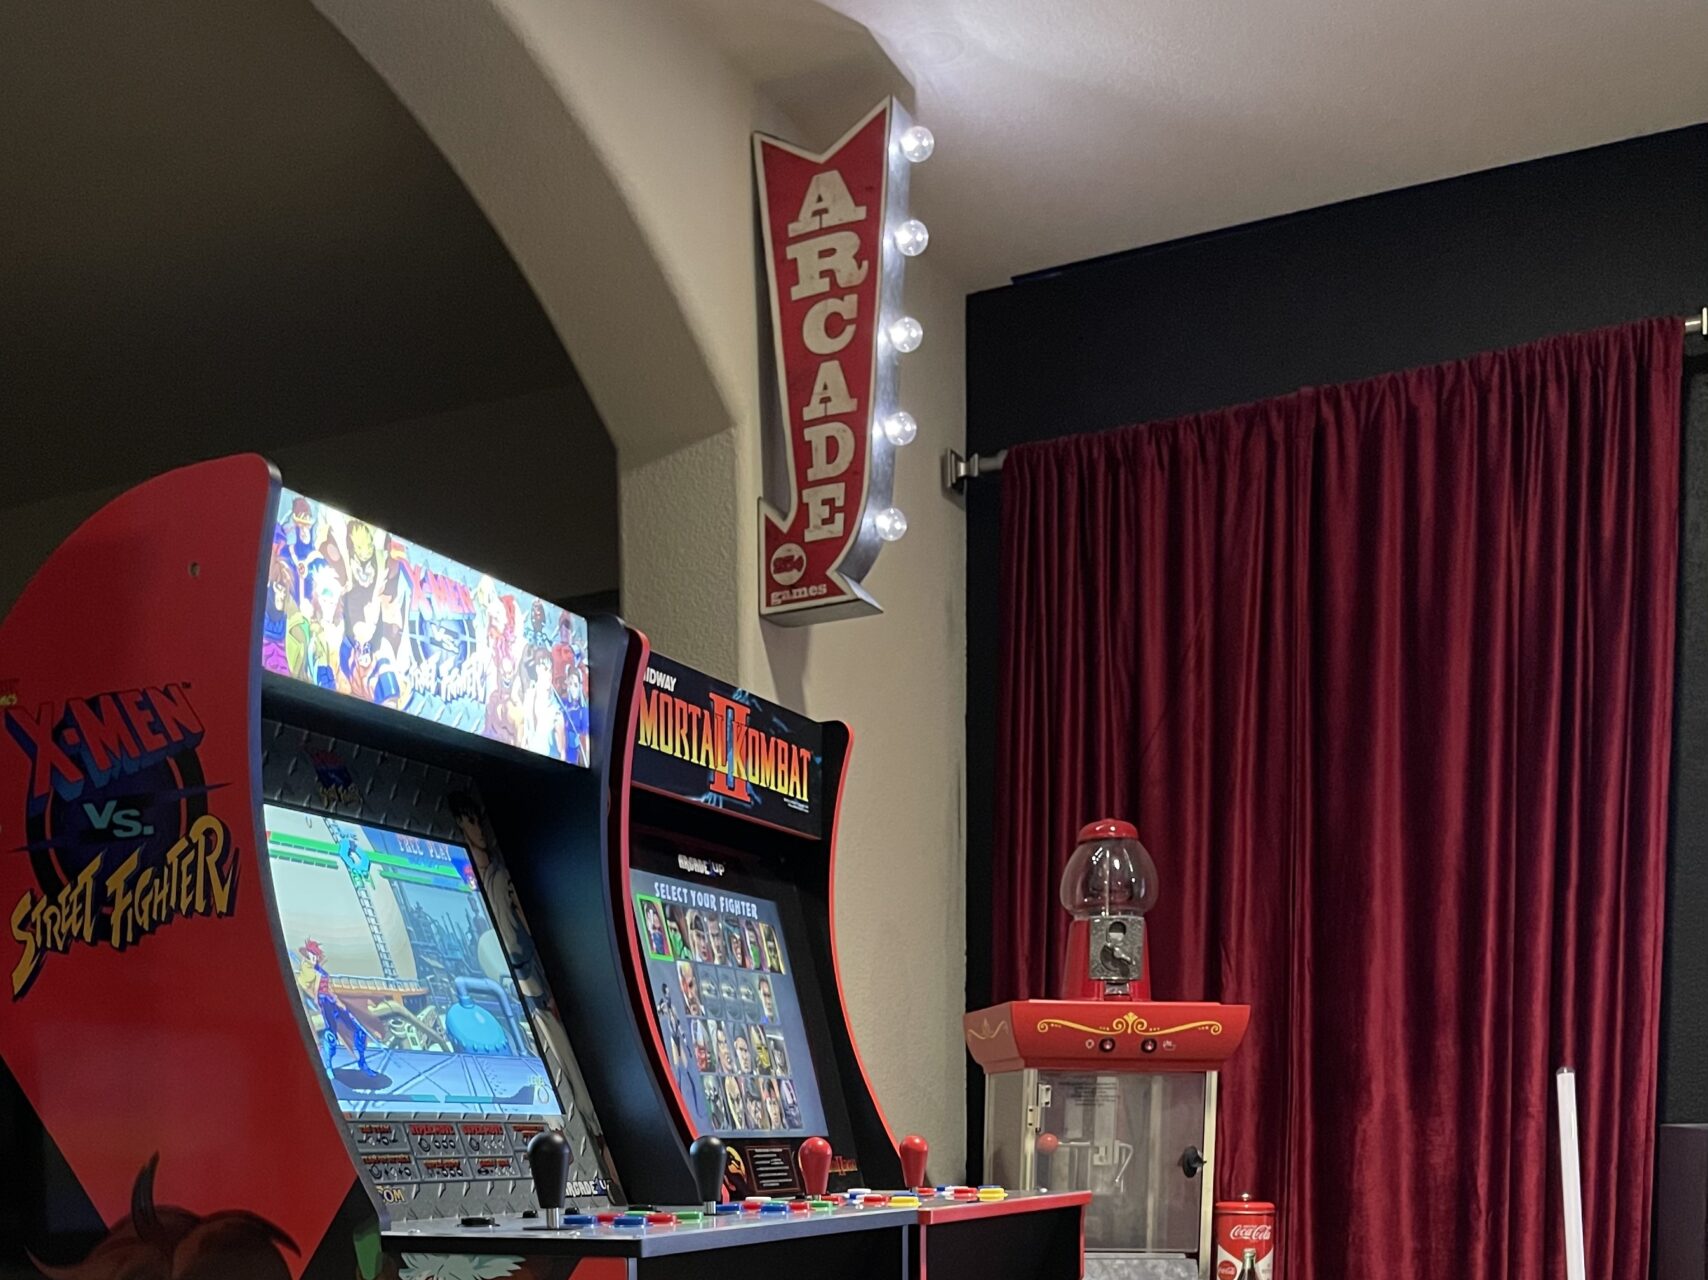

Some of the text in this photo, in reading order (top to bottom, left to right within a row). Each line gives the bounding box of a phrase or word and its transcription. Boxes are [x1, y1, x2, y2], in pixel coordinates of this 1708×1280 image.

[786, 169, 868, 543] ARCADE
[4, 682, 205, 804] X-MEN
[638, 686, 812, 802] MORTAL KOMBAT
[10, 815, 239, 998] STREET FIGHTER
[654, 882, 758, 919] SELECT YOUR FIGHTER
